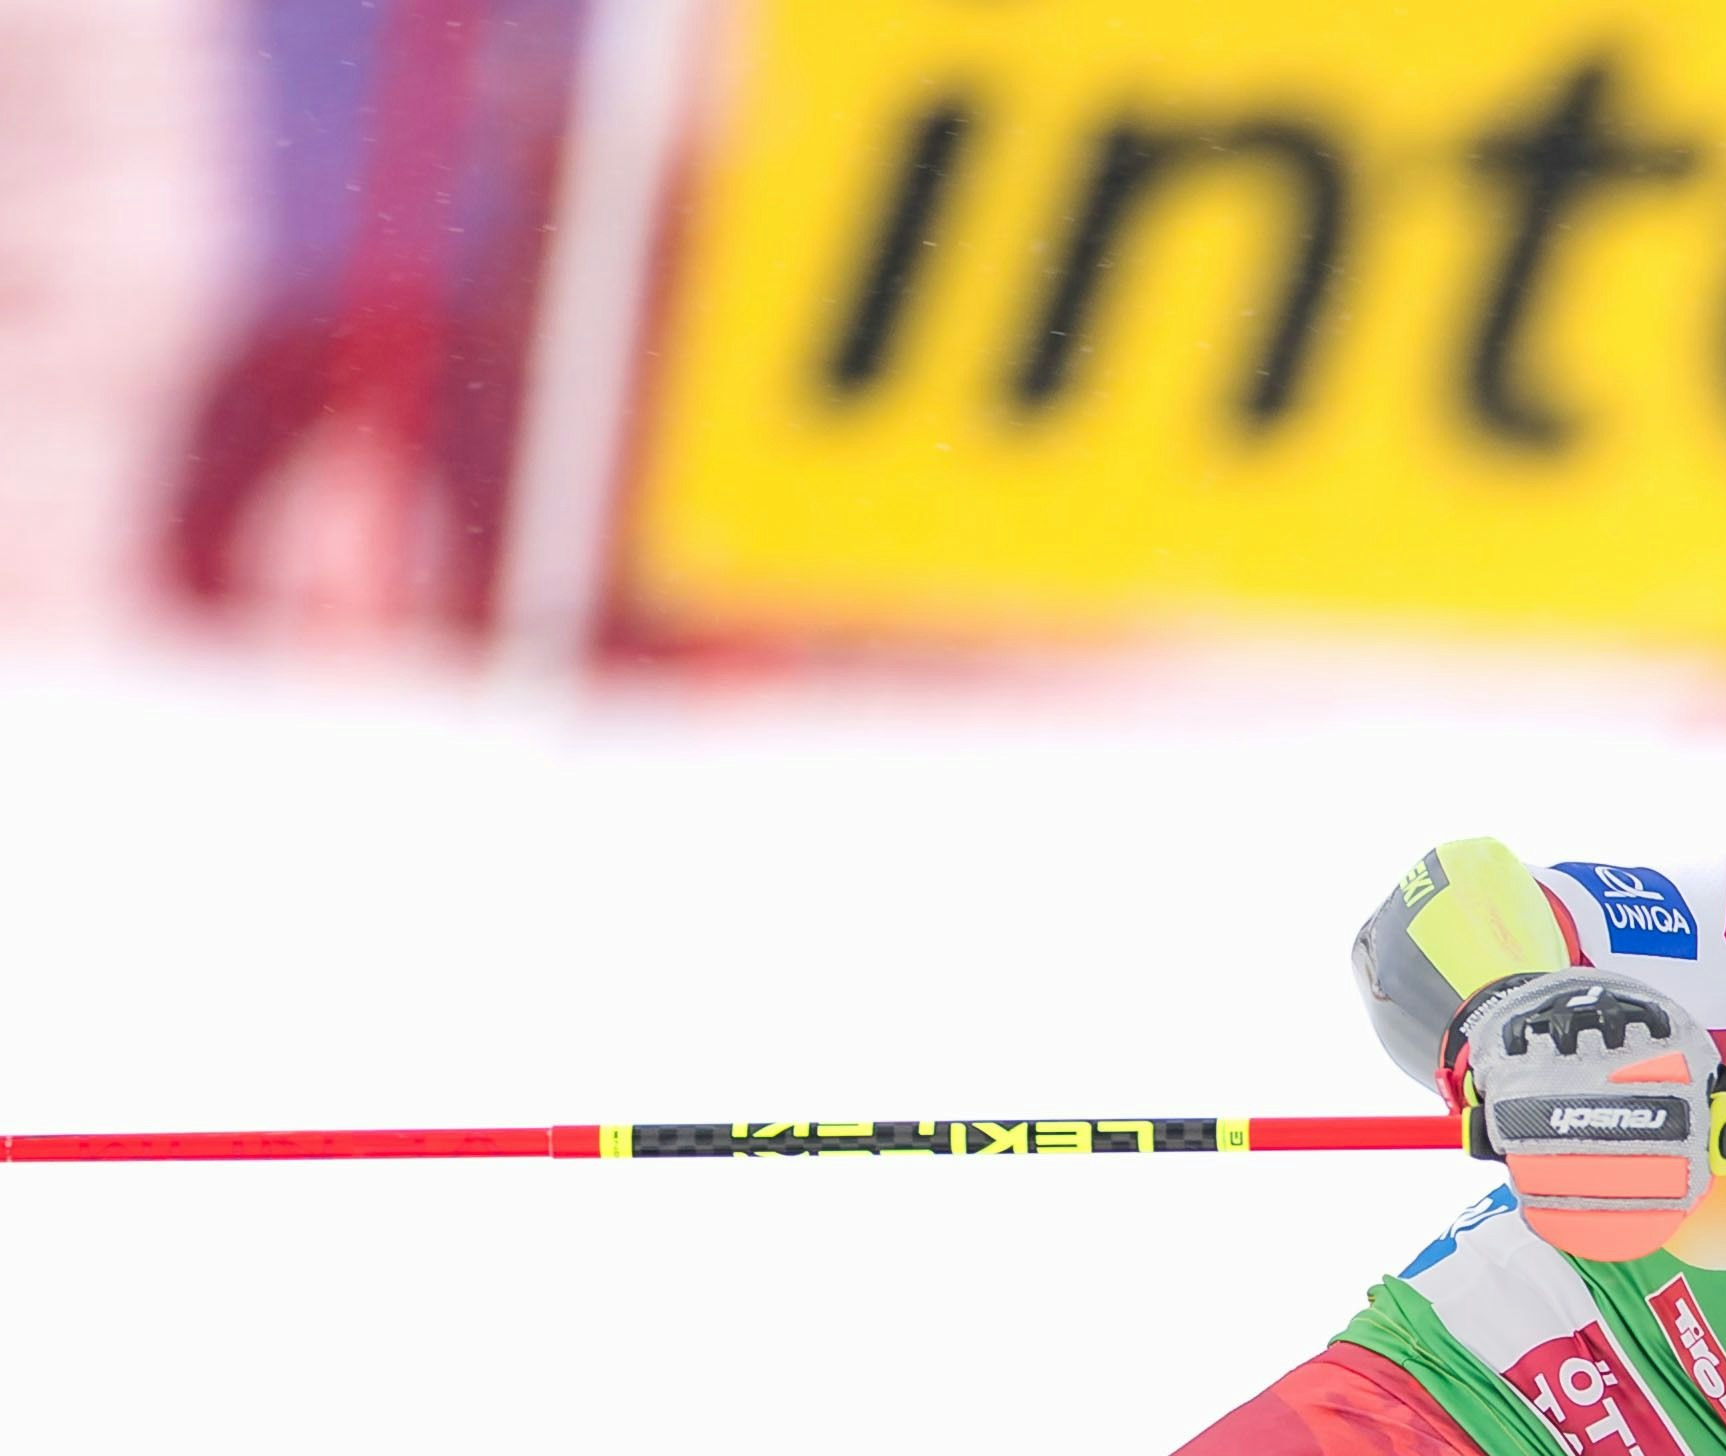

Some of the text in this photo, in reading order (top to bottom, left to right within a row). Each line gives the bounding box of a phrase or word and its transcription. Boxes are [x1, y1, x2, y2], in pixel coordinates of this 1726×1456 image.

[1611, 901, 1692, 936] UNIQA
[1552, 1104, 1667, 1133] reusch
[950, 1120, 1155, 1154] LEKI
